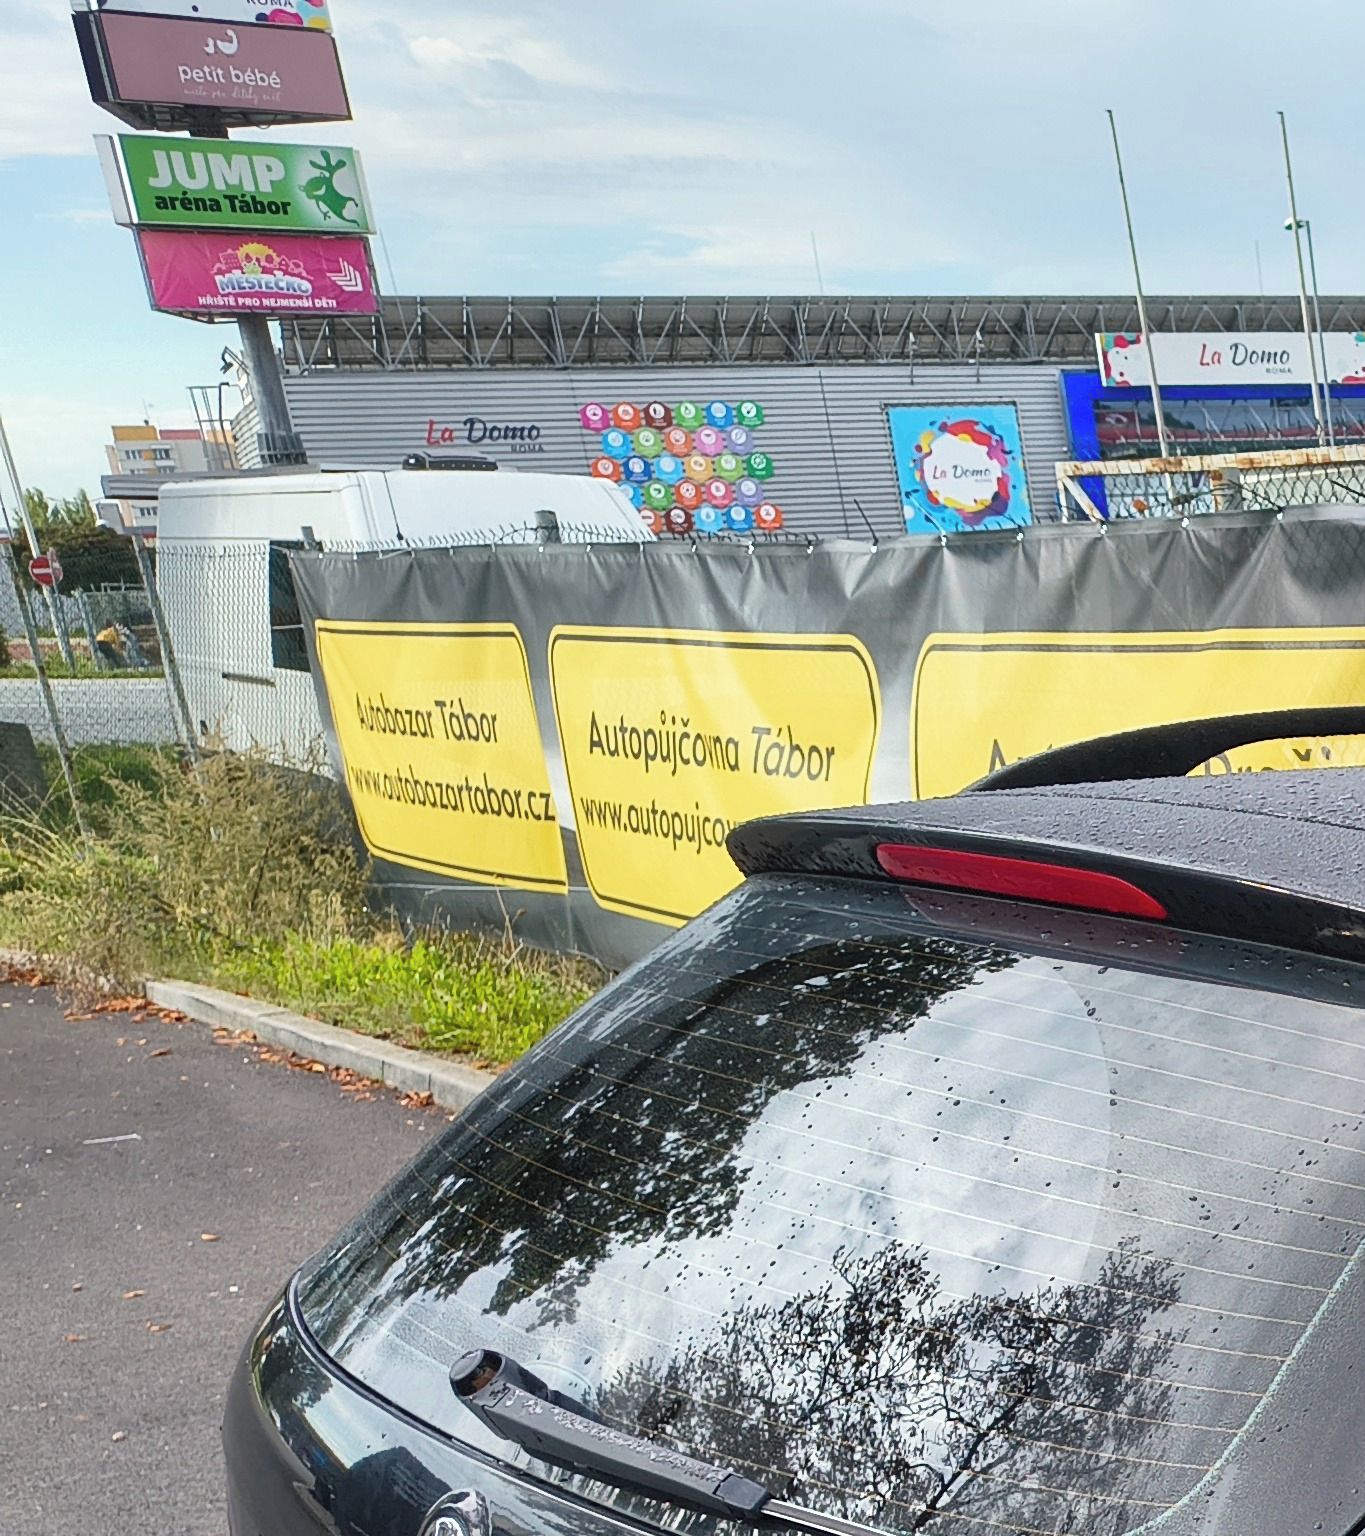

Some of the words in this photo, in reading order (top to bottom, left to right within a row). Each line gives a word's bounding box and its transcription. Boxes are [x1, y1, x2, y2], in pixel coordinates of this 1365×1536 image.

[177, 63, 225, 85] petit
[229, 65, 281, 88] bébé
[148, 149, 285, 193] JUMP
[155, 190, 221, 212] aréna
[223, 193, 291, 215] Tábor
[215, 270, 312, 295] MĚSTEČKO
[198, 294, 236, 308] HŘIŠTĚ
[237, 297, 260, 308] PRO
[262, 295, 313, 308] NEJMENŠÍ
[314, 296, 337, 309] DĚTI
[1199, 343, 1222, 367] La
[1230, 342, 1290, 366] Domo
[426, 418, 454, 446] La
[463, 417, 540, 443] Domo
[932, 465, 947, 480] La
[951, 464, 992, 479] Domo
[356, 692, 434, 738] Autobazar
[434, 698, 498, 743] Tábor
[589, 710, 740, 777] Autopůjčovna
[751, 725, 835, 782] Tábor
[350, 764, 556, 822] www.autobazartabor.cz
